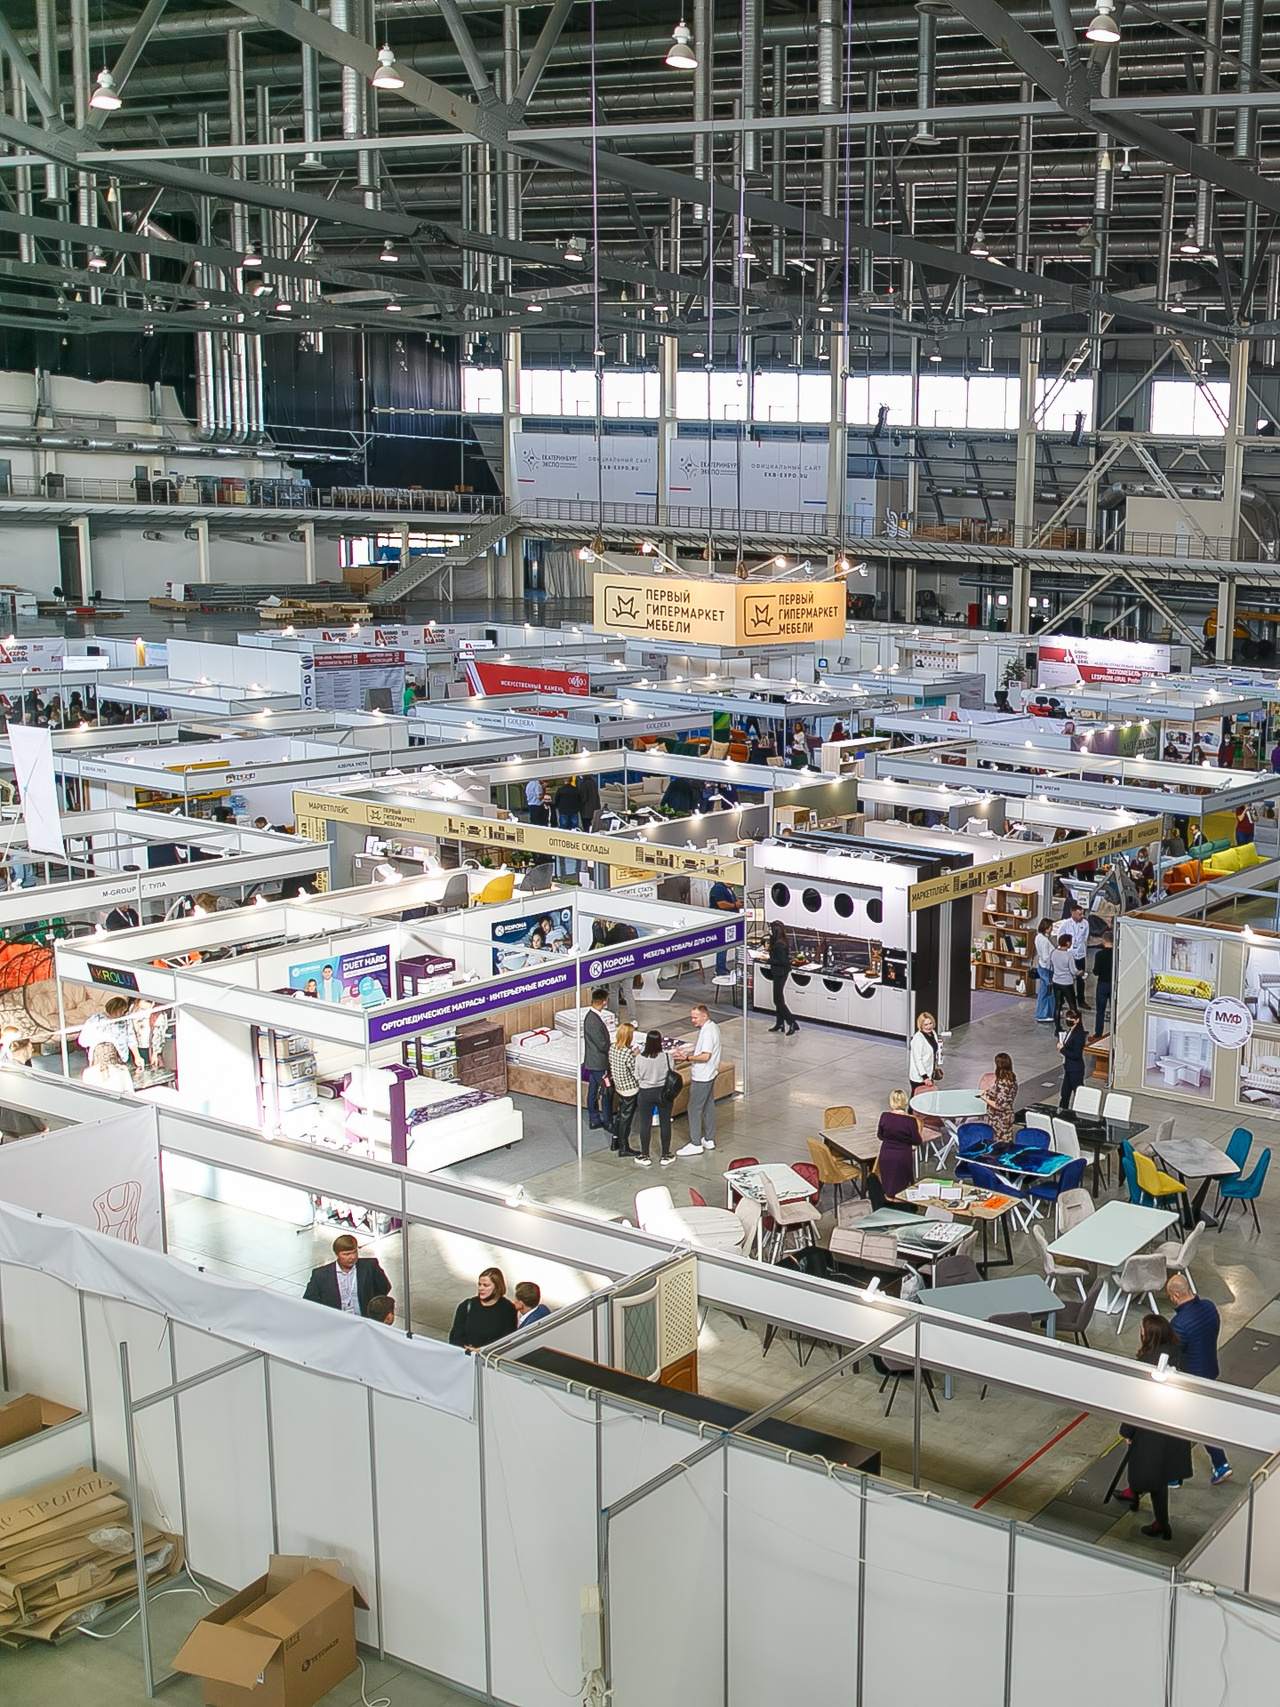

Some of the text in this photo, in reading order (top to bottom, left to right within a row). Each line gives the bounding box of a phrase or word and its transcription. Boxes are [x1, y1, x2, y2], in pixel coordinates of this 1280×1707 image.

[541, 454, 578, 463] ЕКАТЕРИНБУРГ
[700, 461, 739, 471] ЕКТЕРИНБУР
[646, 588, 691, 604] ПЕРВЫЙ
[778, 591, 814, 605] ПЕРВЫЙ
[646, 603, 726, 622] ГИПЕРМАРКЕТ
[778, 606, 839, 621] ГИПЕРМАРКЕТ
[646, 619, 691, 635] МЕБЕЛИ
[778, 622, 814, 636] МЕБЕЛИ
[1091, 673, 1127, 683] LESPROM-URAL
[500, 680, 564, 693] ИСКУССТВЕННЫЙ КАМЕНЬ
[508, 718, 534, 728] GOLDERA
[646, 721, 671, 731] GOLDERA
[308, 801, 349, 816] МАРКЕТПЛЕЙС
[383, 806, 402, 815] ПЕРВЫЙ
[383, 813, 416, 824] ГИПЕРМАРКЕТ
[383, 820, 403, 828] МЕБЕЛИ
[548, 837, 611, 856] ОПТОВЫЕ СКЛАДЫ
[1045, 852, 1069, 865] ГИПЕРМАРКЕТ
[102, 886, 137, 898] M-GROUP
[149, 881, 167, 890] ТУЛА
[638, 886, 654, 894] СТАТЬ
[912, 878, 951, 903] МАРКЕТПЛЕЙС
[505, 922, 527, 930] КОРОНА
[643, 934, 718, 960] МЕБЕЛЬ И ТОВАРЫ ДЛЯ СНА
[343, 960, 364, 971] DUET
[364, 954, 387, 966] HARD
[434, 962, 453, 970] КОРОНА
[603, 954, 635, 969] КОРОНА
[301, 965, 321, 973] КОРОНА
[381, 974, 567, 1032] ОРТОПЕДИЧЕСКИЕ МАТРАСЫ ИНТЕРЬЕРНЫЕ КРОВАТИ
[1215, 1011, 1243, 1024] ММФ
[18, 1478, 113, 1518] ТРОГАТЬ
